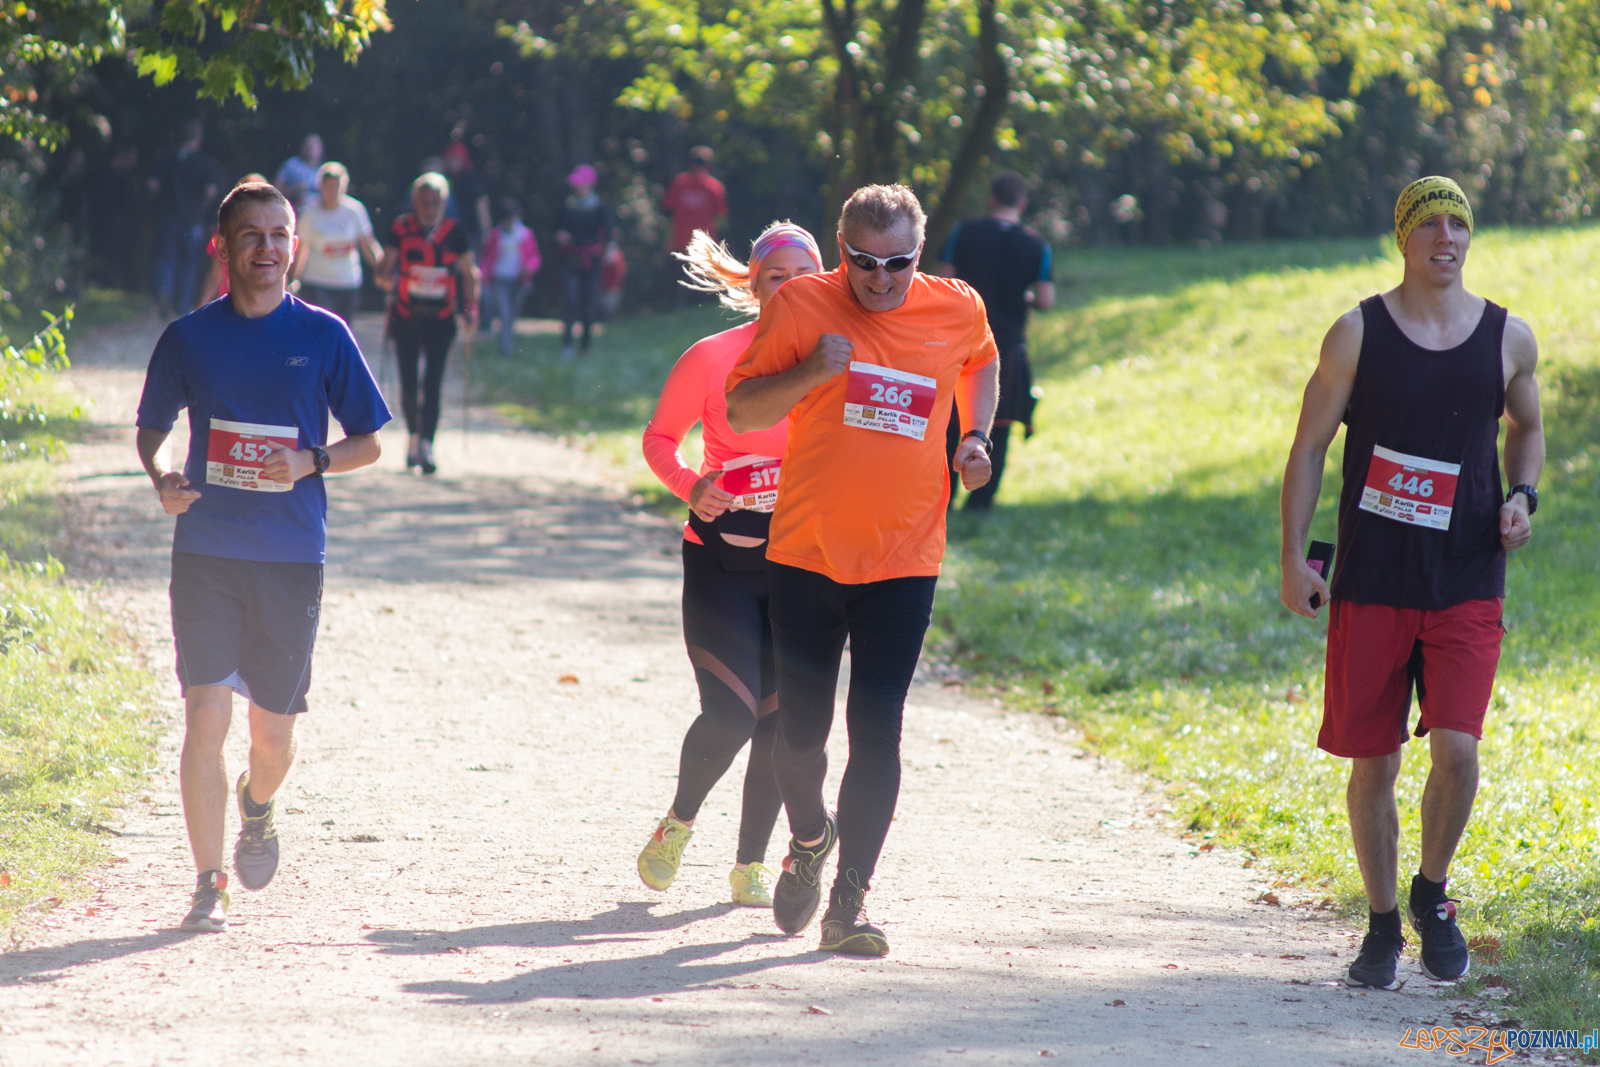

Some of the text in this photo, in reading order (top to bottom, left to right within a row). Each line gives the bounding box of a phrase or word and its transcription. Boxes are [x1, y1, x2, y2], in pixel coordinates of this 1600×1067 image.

[870, 383, 912, 407] 266
[878, 410, 898, 418] Karlik
[229, 441, 272, 463] 452
[749, 466, 780, 488] 317
[1388, 472, 1434, 497] 446
[1394, 498, 1415, 508] Karlik
